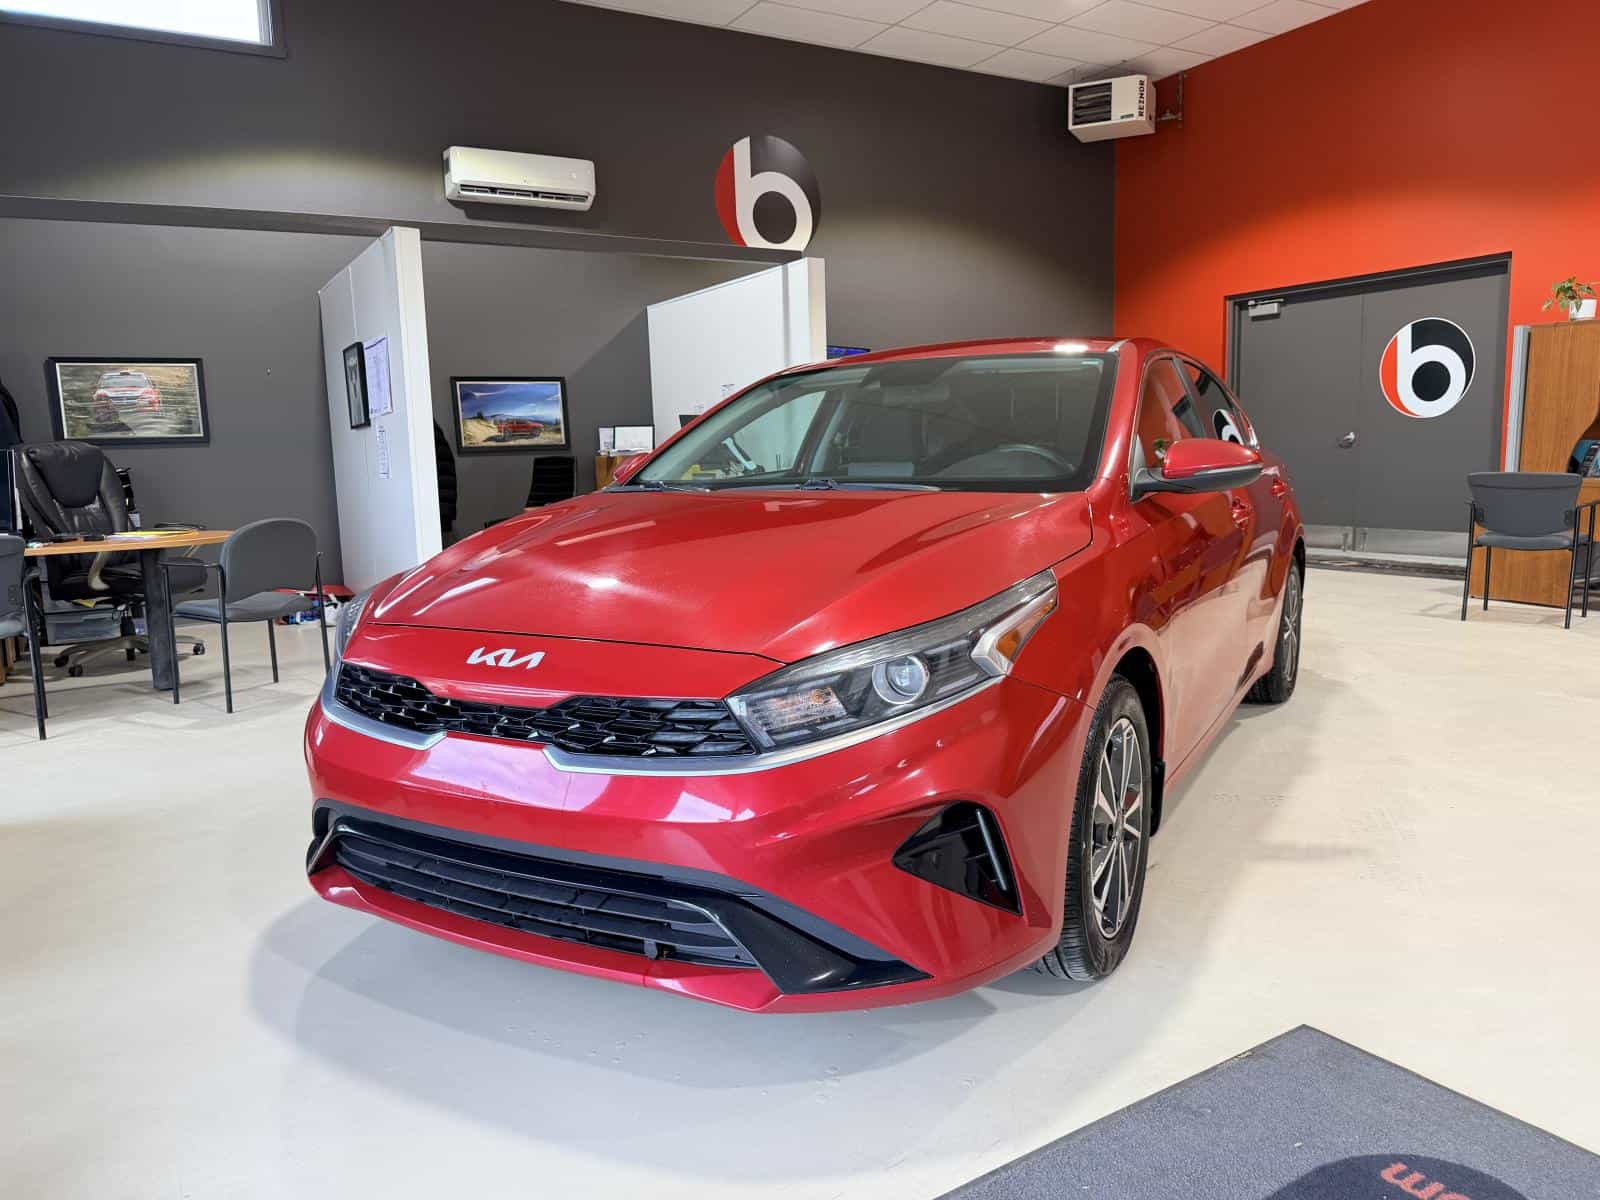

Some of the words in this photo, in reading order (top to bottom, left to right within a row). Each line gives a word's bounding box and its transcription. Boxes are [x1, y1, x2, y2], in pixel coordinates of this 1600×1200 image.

[733, 136, 813, 252] b
[1396, 322, 1466, 418] b
[466, 646, 546, 669] KIA
